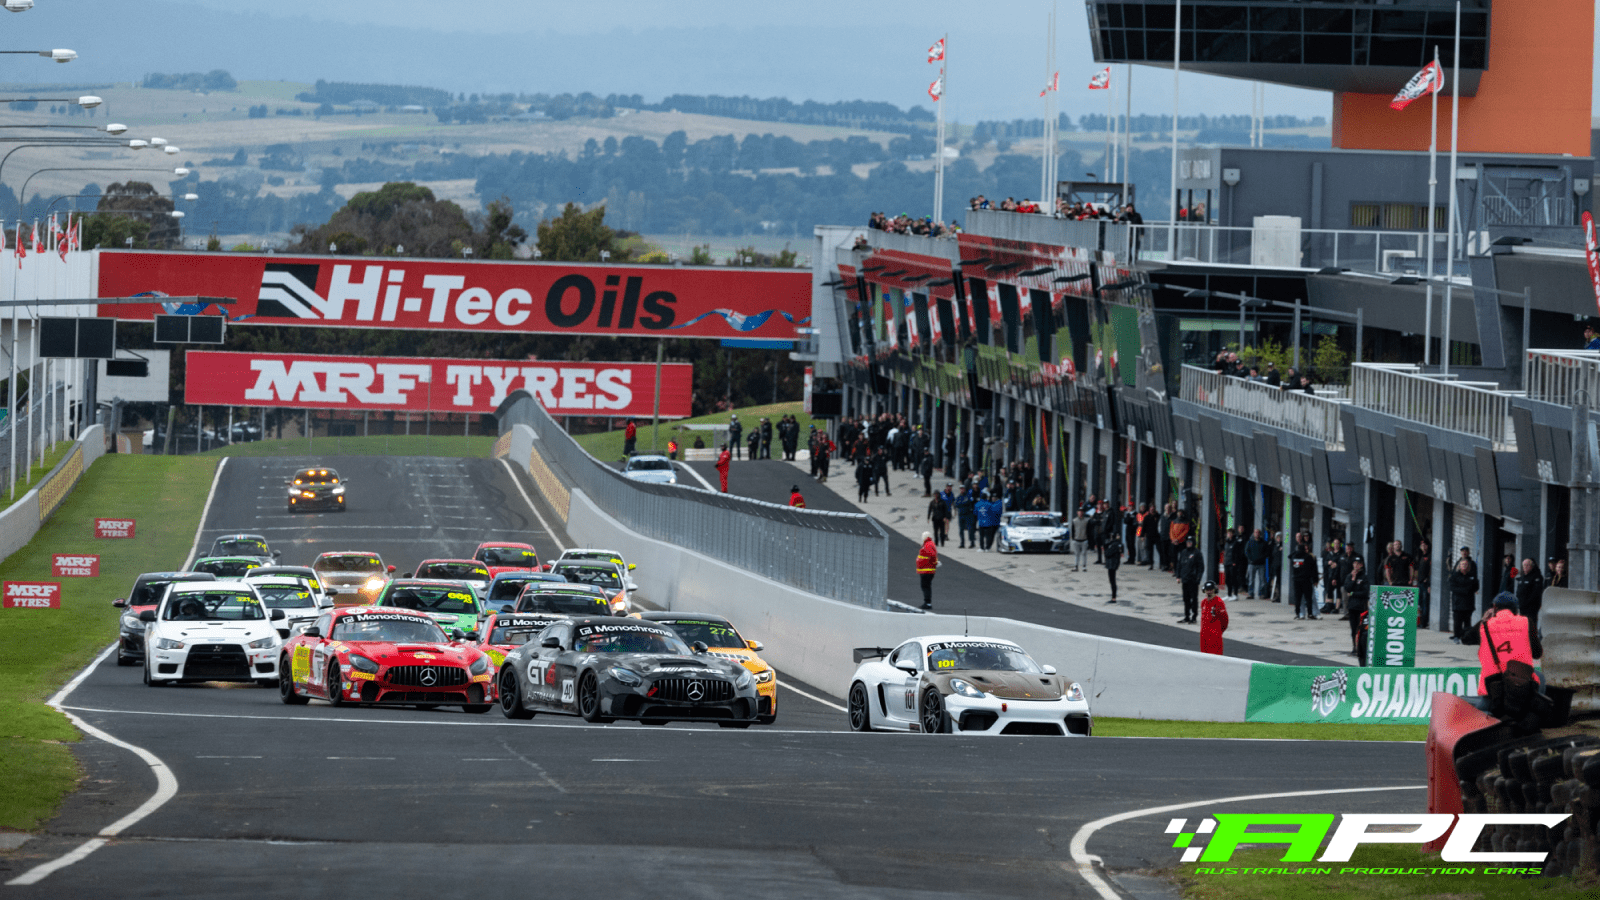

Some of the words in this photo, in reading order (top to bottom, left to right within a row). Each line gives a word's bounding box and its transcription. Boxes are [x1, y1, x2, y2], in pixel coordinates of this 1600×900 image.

[324, 264, 533, 326] Hi-Tec
[545, 274, 678, 330] Oils
[244, 360, 430, 405] MRF
[446, 365, 633, 410] TYRES
[98, 520, 133, 529] MRF
[102, 529, 128, 538] TYRES
[55, 556, 97, 567] MRF
[60, 567, 91, 576] TYRES
[7, 584, 58, 597] MRF
[13, 598, 51, 608] TYRES
[357, 613, 433, 626] Monochrome
[594, 624, 673, 637] Monochrome
[944, 641, 1022, 653] Monochrome
[1497, 640, 1513, 654] 4
[938, 659, 955, 668] 101
[527, 659, 556, 687] GT4
[564, 684, 573, 700] 40
[904, 689, 915, 711] 101
